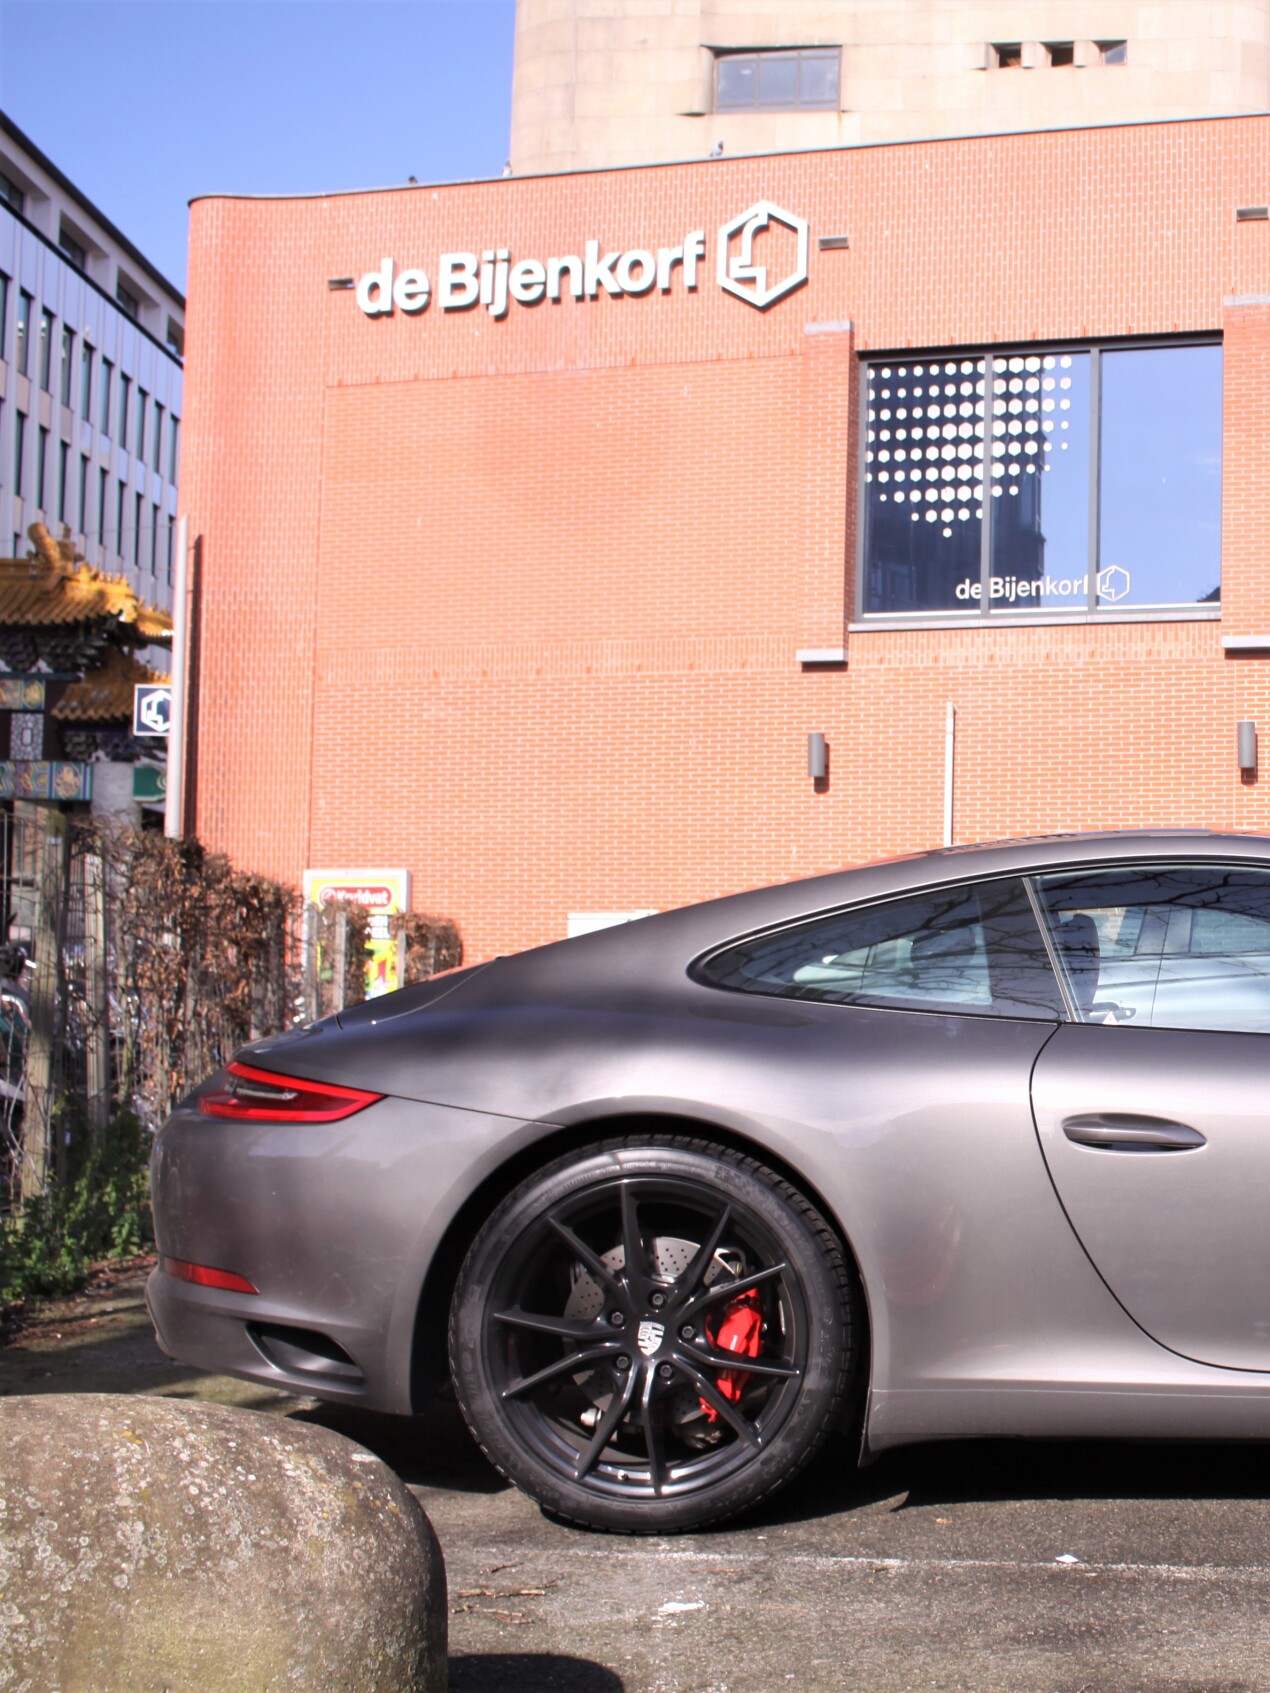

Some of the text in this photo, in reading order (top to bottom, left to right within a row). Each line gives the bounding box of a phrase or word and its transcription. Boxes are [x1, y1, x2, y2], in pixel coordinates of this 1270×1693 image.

[357, 231, 705, 317] de Bijenkorf
[955, 578, 982, 600] de
